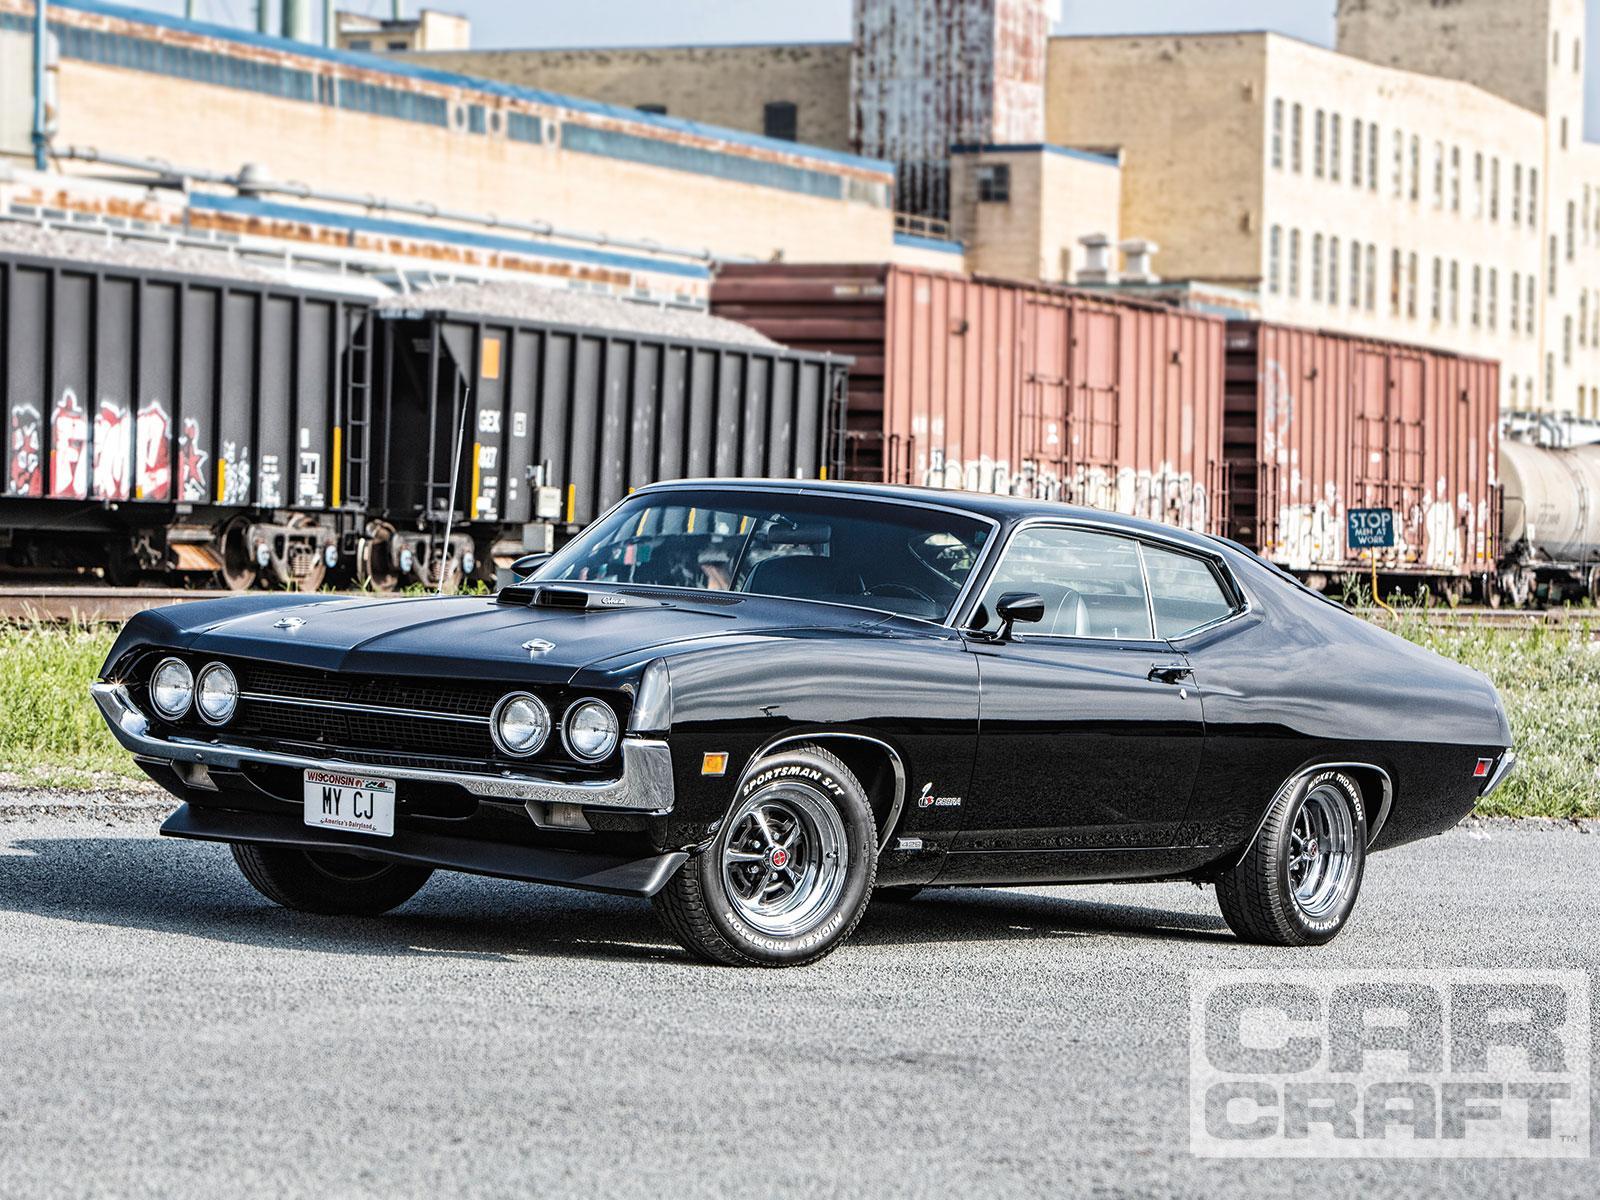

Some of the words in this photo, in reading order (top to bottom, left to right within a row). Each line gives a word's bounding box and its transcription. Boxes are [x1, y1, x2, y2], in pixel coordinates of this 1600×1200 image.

[1350, 512, 1391, 528] STOP
[1355, 528, 1373, 536] MEN
[1376, 527, 1386, 536] AT
[1358, 536, 1384, 545] WORK
[307, 771, 354, 787] WISCONSIN
[743, 766, 822, 796] SPORTSMAN
[822, 777, 845, 796] S/T
[322, 786, 342, 816] MY
[353, 791, 374, 820] CJ
[1306, 771, 1335, 794] MICKEY
[1336, 773, 1363, 821] THOMPSON
[324, 817, 348, 828] America's
[348, 820, 373, 831] Dairyland
[725, 912, 791, 951] THOMPSON
[796, 911, 843, 949] MICKEY
